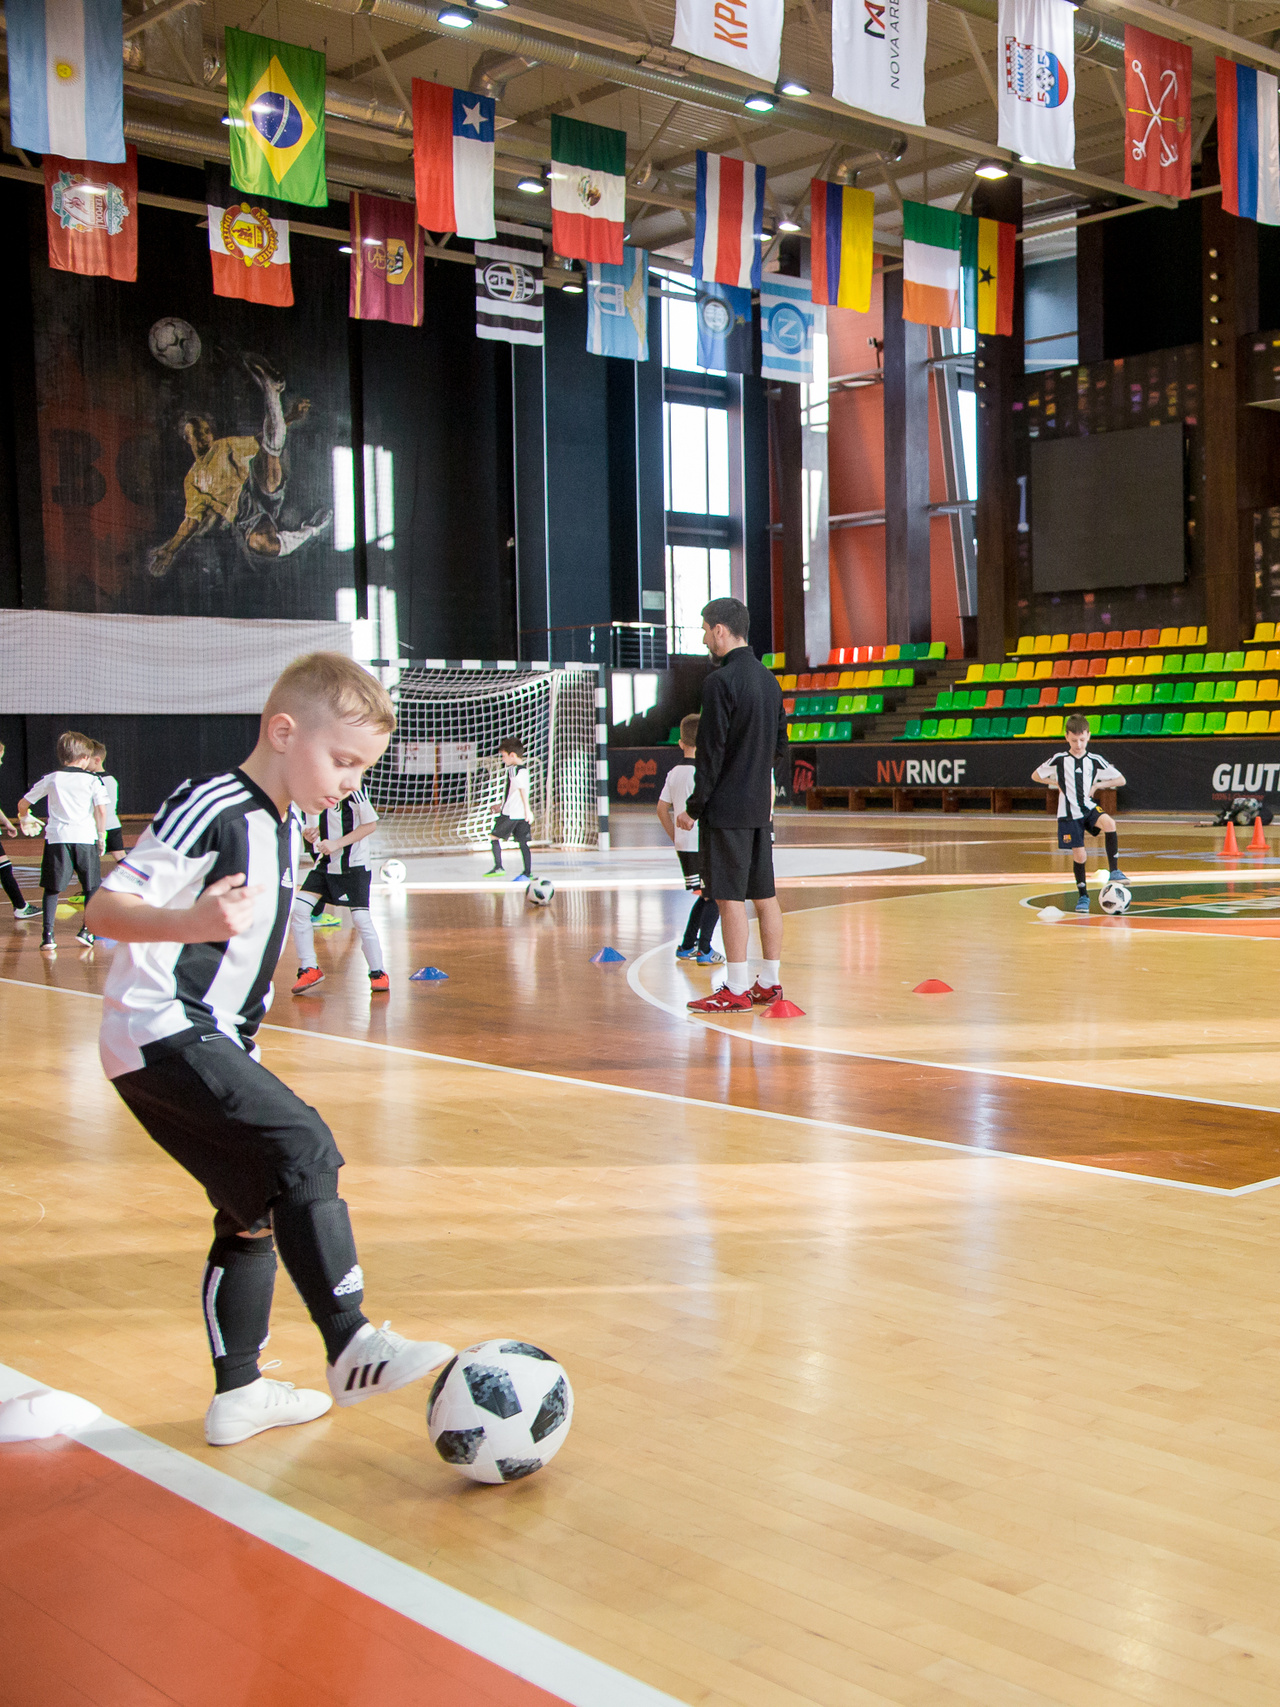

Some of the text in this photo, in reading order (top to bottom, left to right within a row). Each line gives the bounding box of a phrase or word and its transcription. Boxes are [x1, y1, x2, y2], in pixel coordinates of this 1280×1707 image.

[889, 37, 901, 90] NOVA
[223, 214, 236, 250] UNITED
[779, 317, 798, 341] N
[876, 759, 967, 785] NVRNCF
